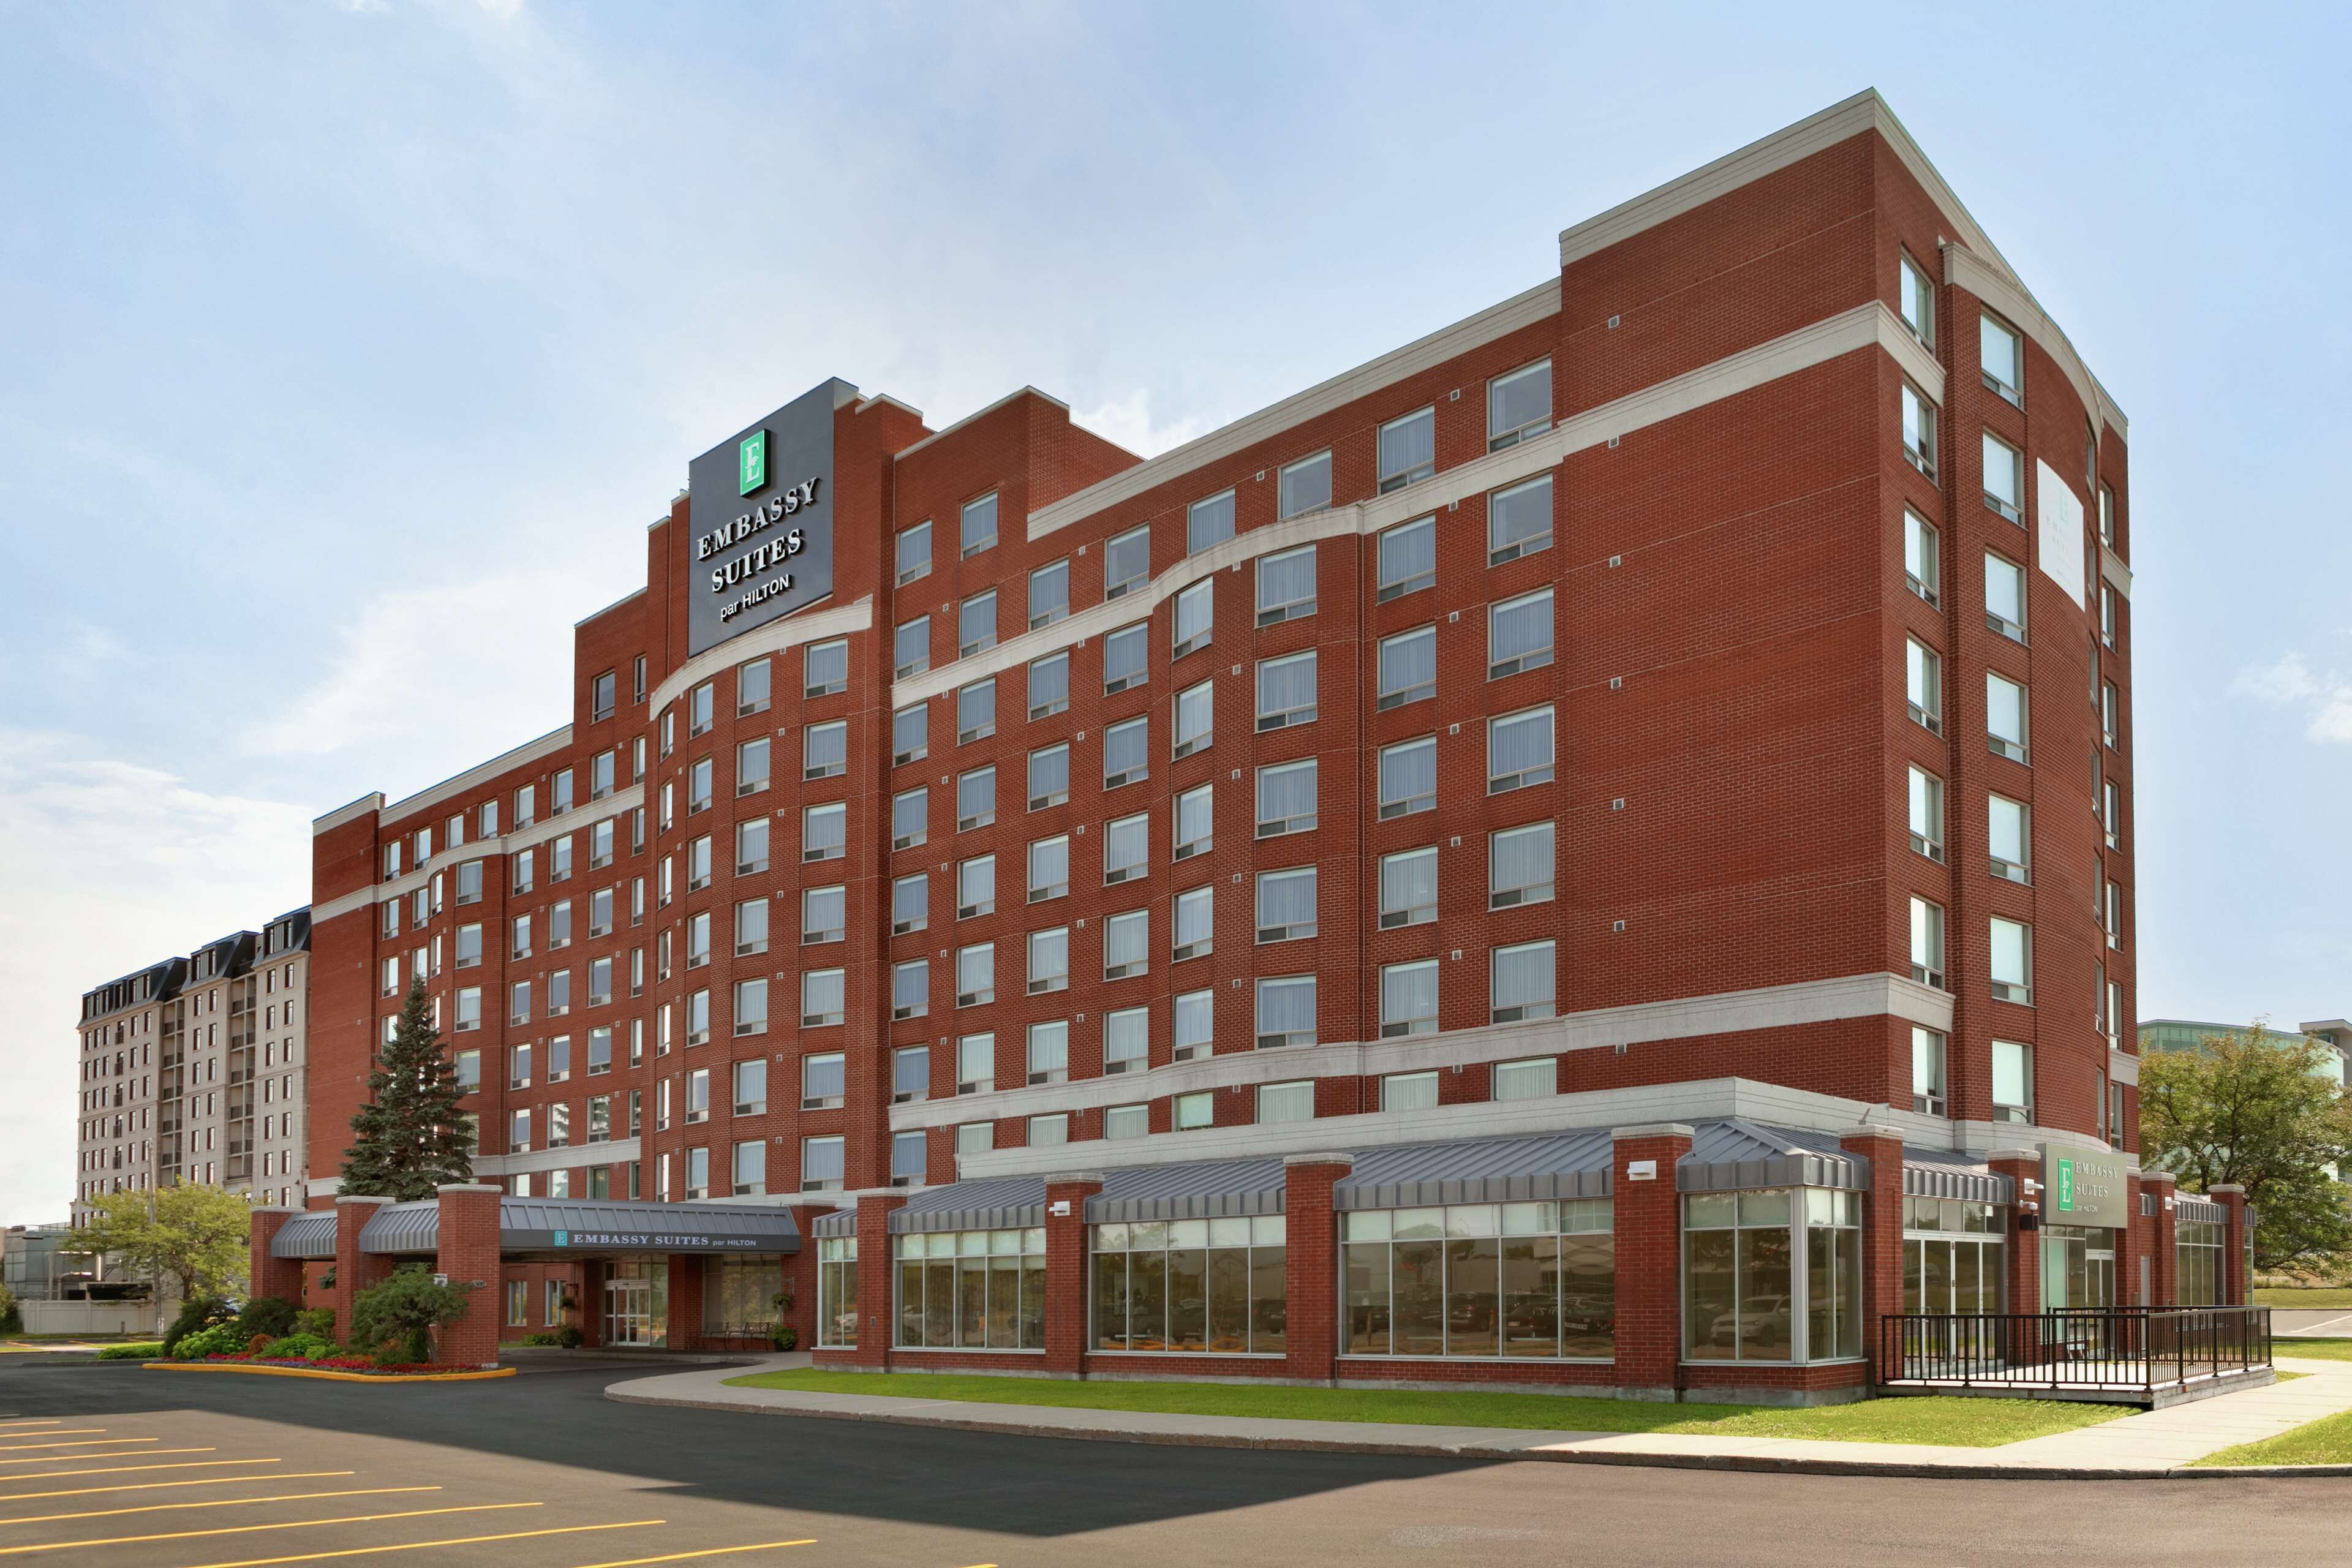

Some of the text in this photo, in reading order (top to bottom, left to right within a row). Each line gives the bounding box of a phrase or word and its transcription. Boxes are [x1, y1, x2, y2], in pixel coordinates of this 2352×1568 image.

[697, 477, 818, 560] EMBASSY
[712, 529, 801, 593] SUITES
[720, 574, 790, 622] par HILTON
[2075, 1162, 2118, 1179] EMBASSY
[2076, 1183, 2108, 1197] SUITES
[573, 1234, 649, 1244] EMBASSY
[655, 1235, 709, 1245] SUITES
